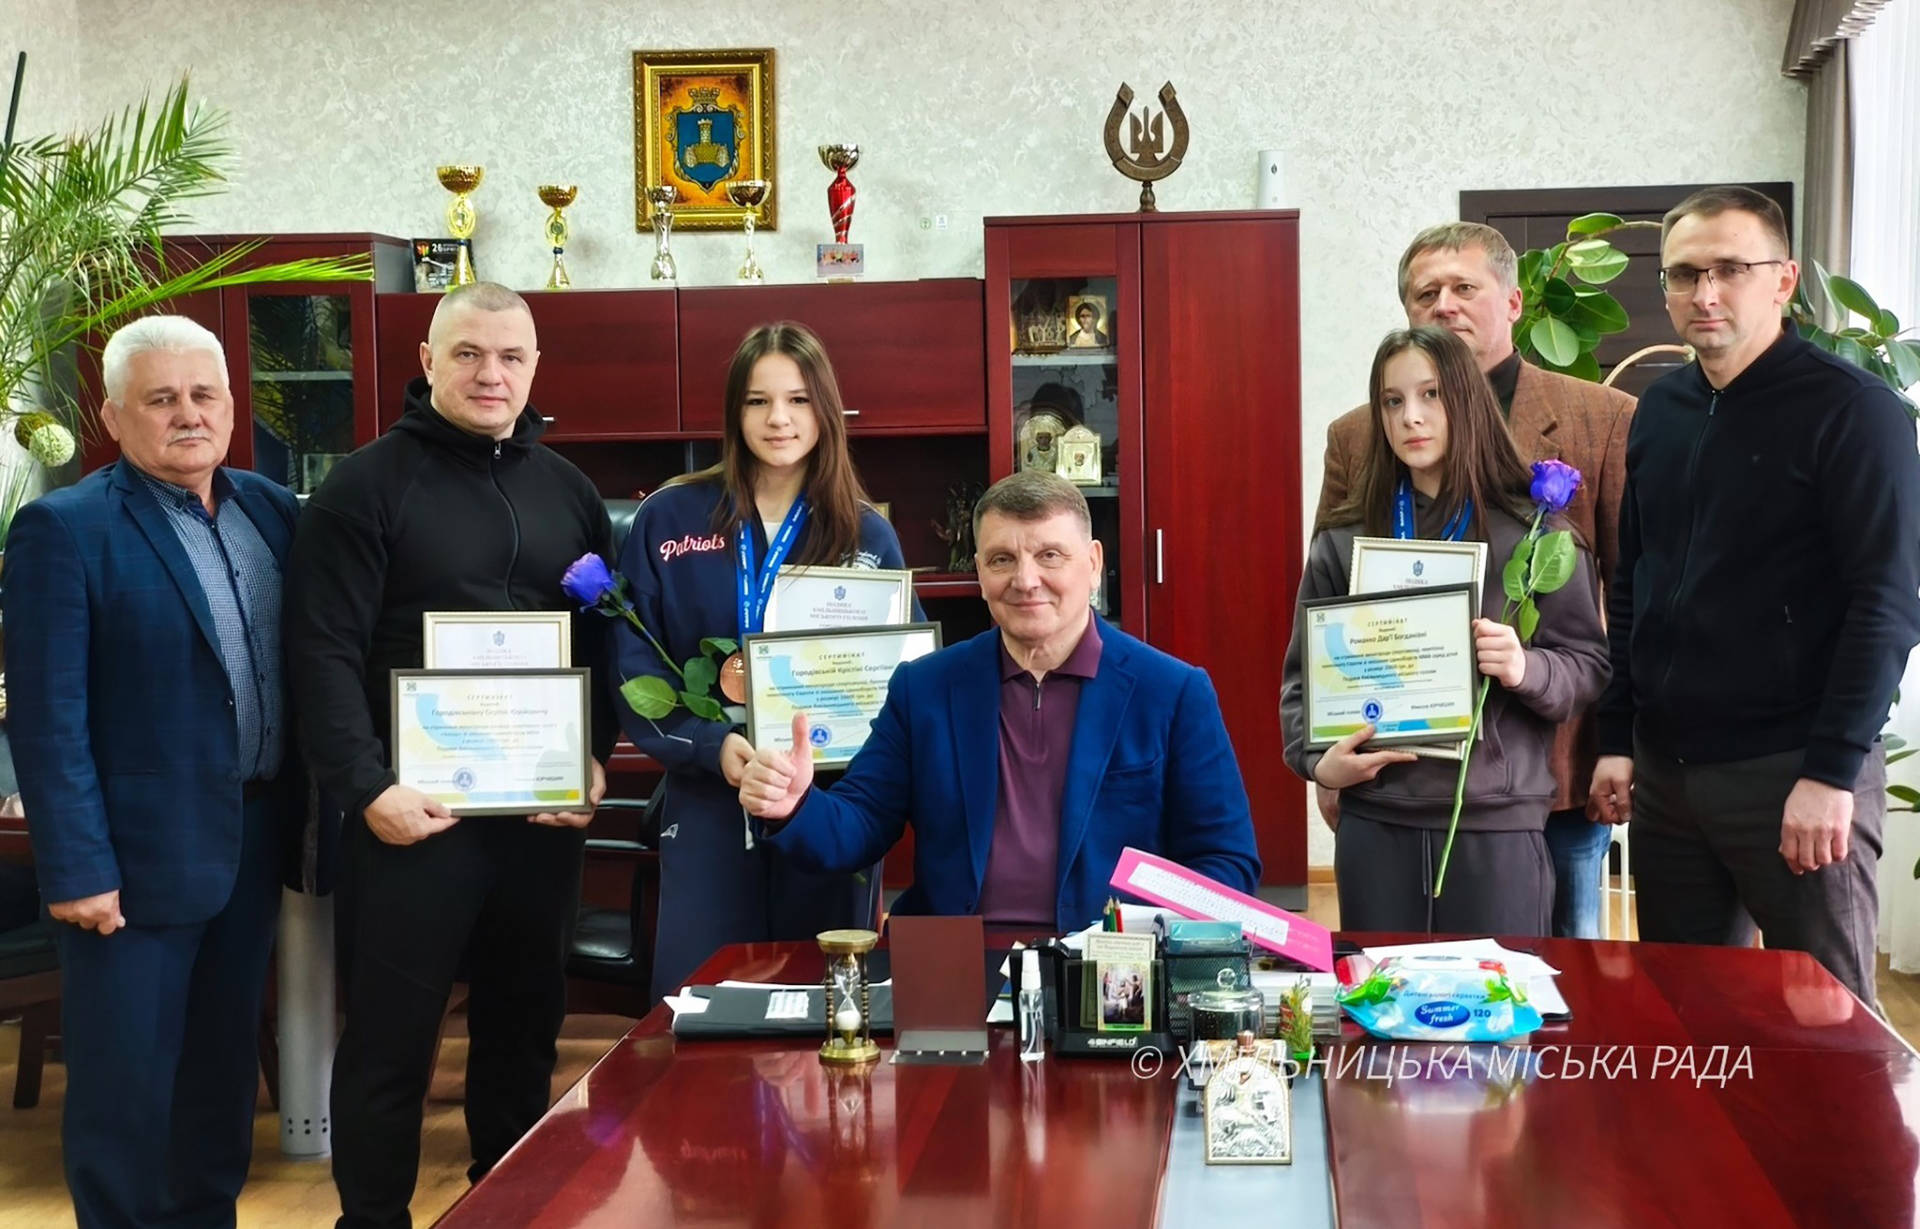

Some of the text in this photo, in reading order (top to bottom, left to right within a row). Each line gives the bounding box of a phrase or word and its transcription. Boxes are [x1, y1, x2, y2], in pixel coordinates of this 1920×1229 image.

[659, 533, 725, 562] Patriots
[1420, 1004, 1460, 1015] Summer
[1473, 1009, 1491, 1018] 120
[1429, 1012, 1453, 1025] fresh
